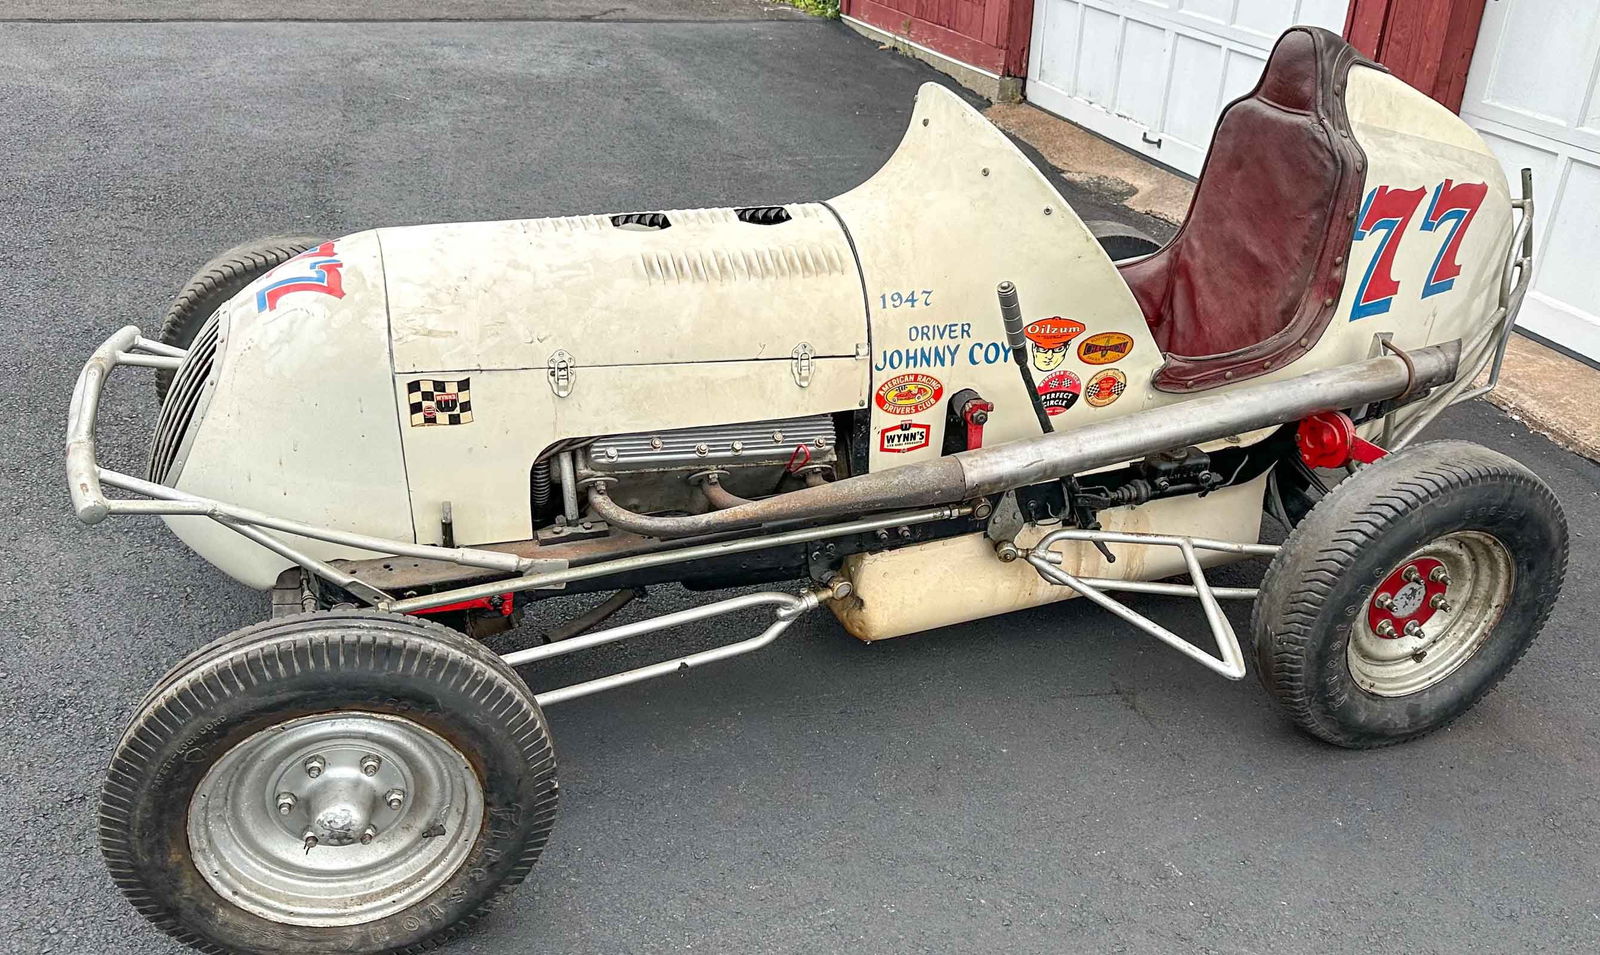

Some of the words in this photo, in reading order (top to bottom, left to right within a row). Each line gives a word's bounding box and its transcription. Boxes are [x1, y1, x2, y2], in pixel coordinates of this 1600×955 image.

[1349, 179, 1488, 322] 77
[880, 290, 933, 309] 1947
[908, 322, 971, 341] DRIVER
[1027, 323, 1080, 334] Oilzum
[875, 343, 960, 371] JOHNNY
[968, 341, 1012, 366] COY
[878, 374, 915, 396] AMERICAN
[916, 375, 941, 390] RACING
[883, 403, 916, 414] DRIVERS
[917, 398, 936, 412] CLUB
[1041, 392, 1073, 401] PERFECT
[886, 431, 925, 444] WYNN'S
